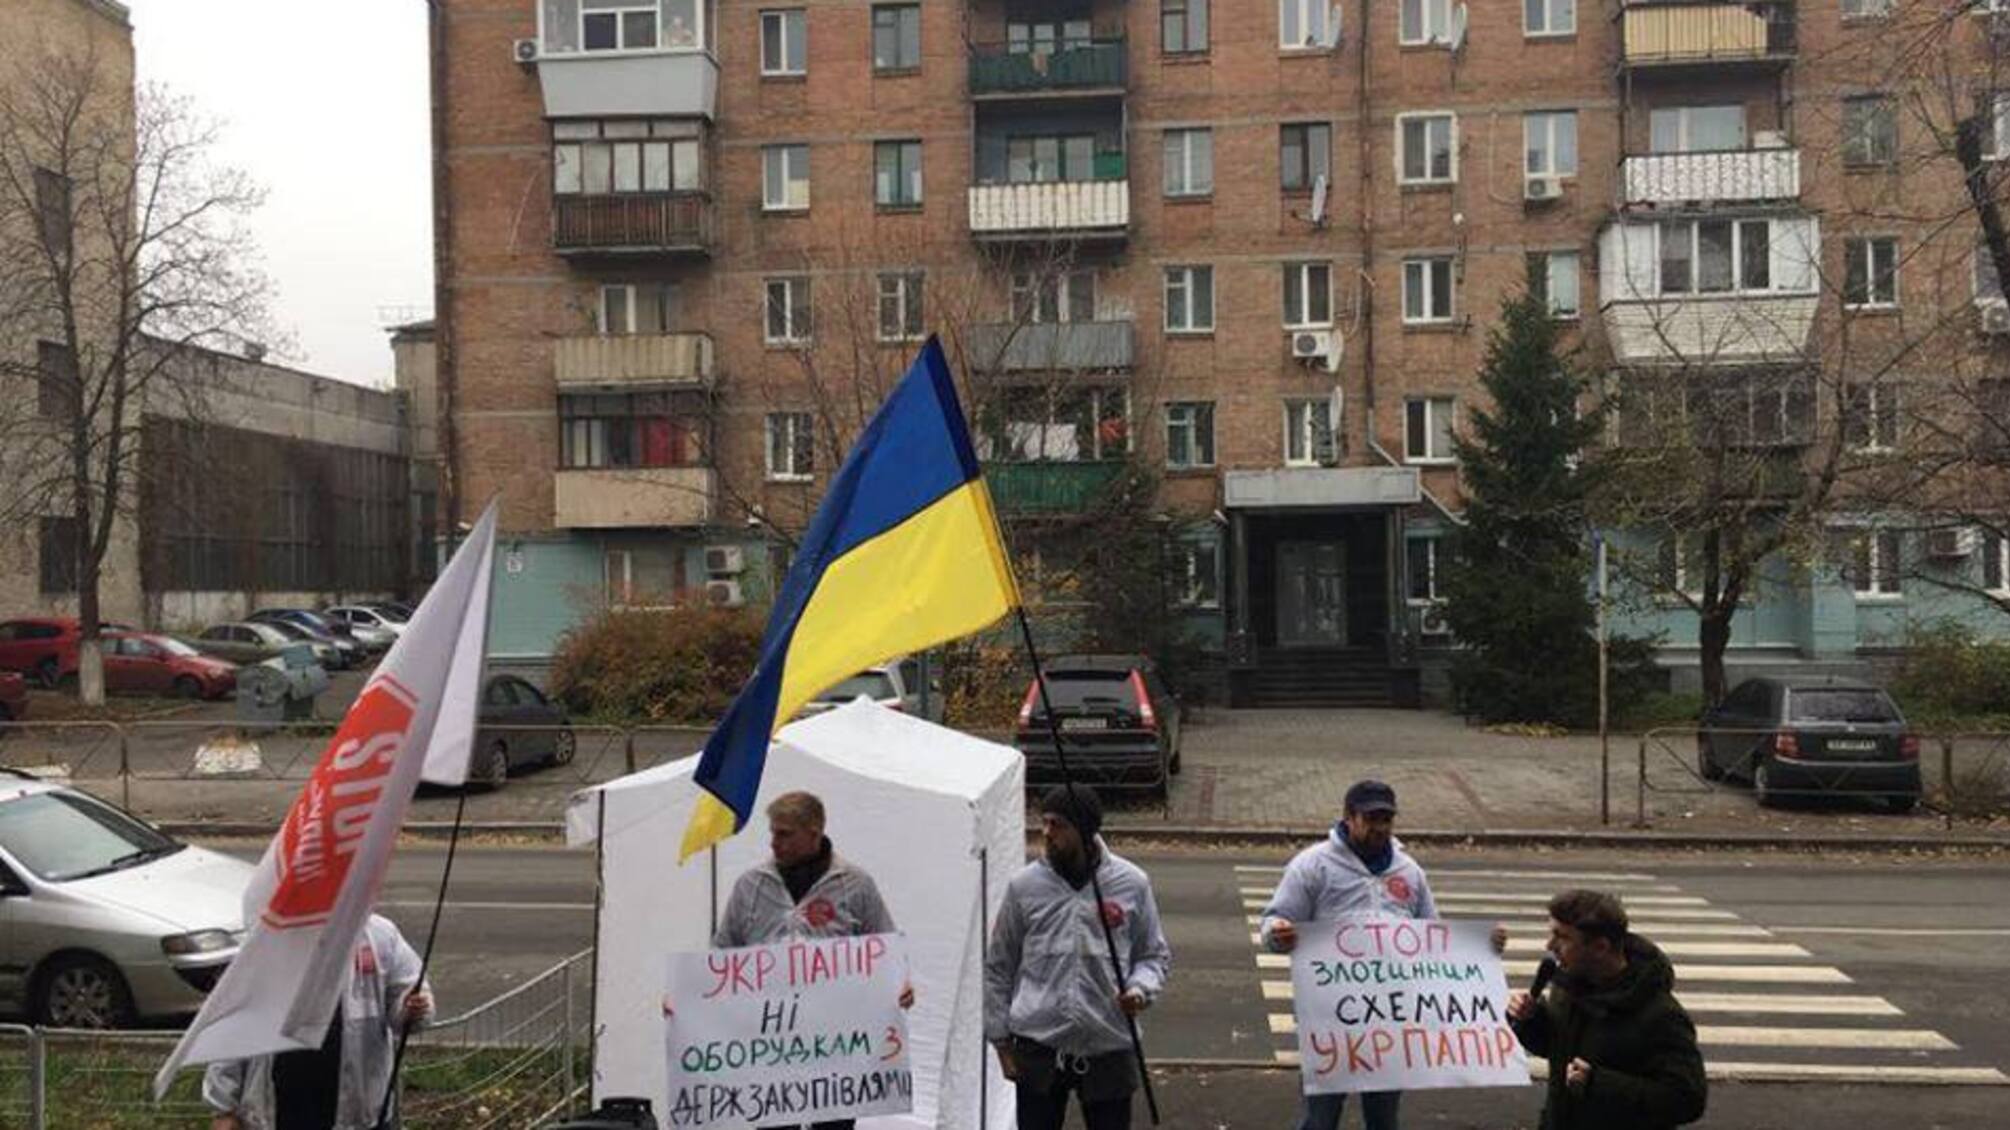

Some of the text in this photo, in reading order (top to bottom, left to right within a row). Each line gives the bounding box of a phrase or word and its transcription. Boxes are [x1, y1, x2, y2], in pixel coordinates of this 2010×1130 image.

[1335, 923, 1449, 958] СТОП
[702, 936, 886, 998] УКР ПАПІР
[1310, 960, 1485, 987] ЗЛОЧИННИМ
[1335, 991, 1498, 1025] СХЕМАМ
[680, 1029, 872, 1072] ОБОРУДКАМ
